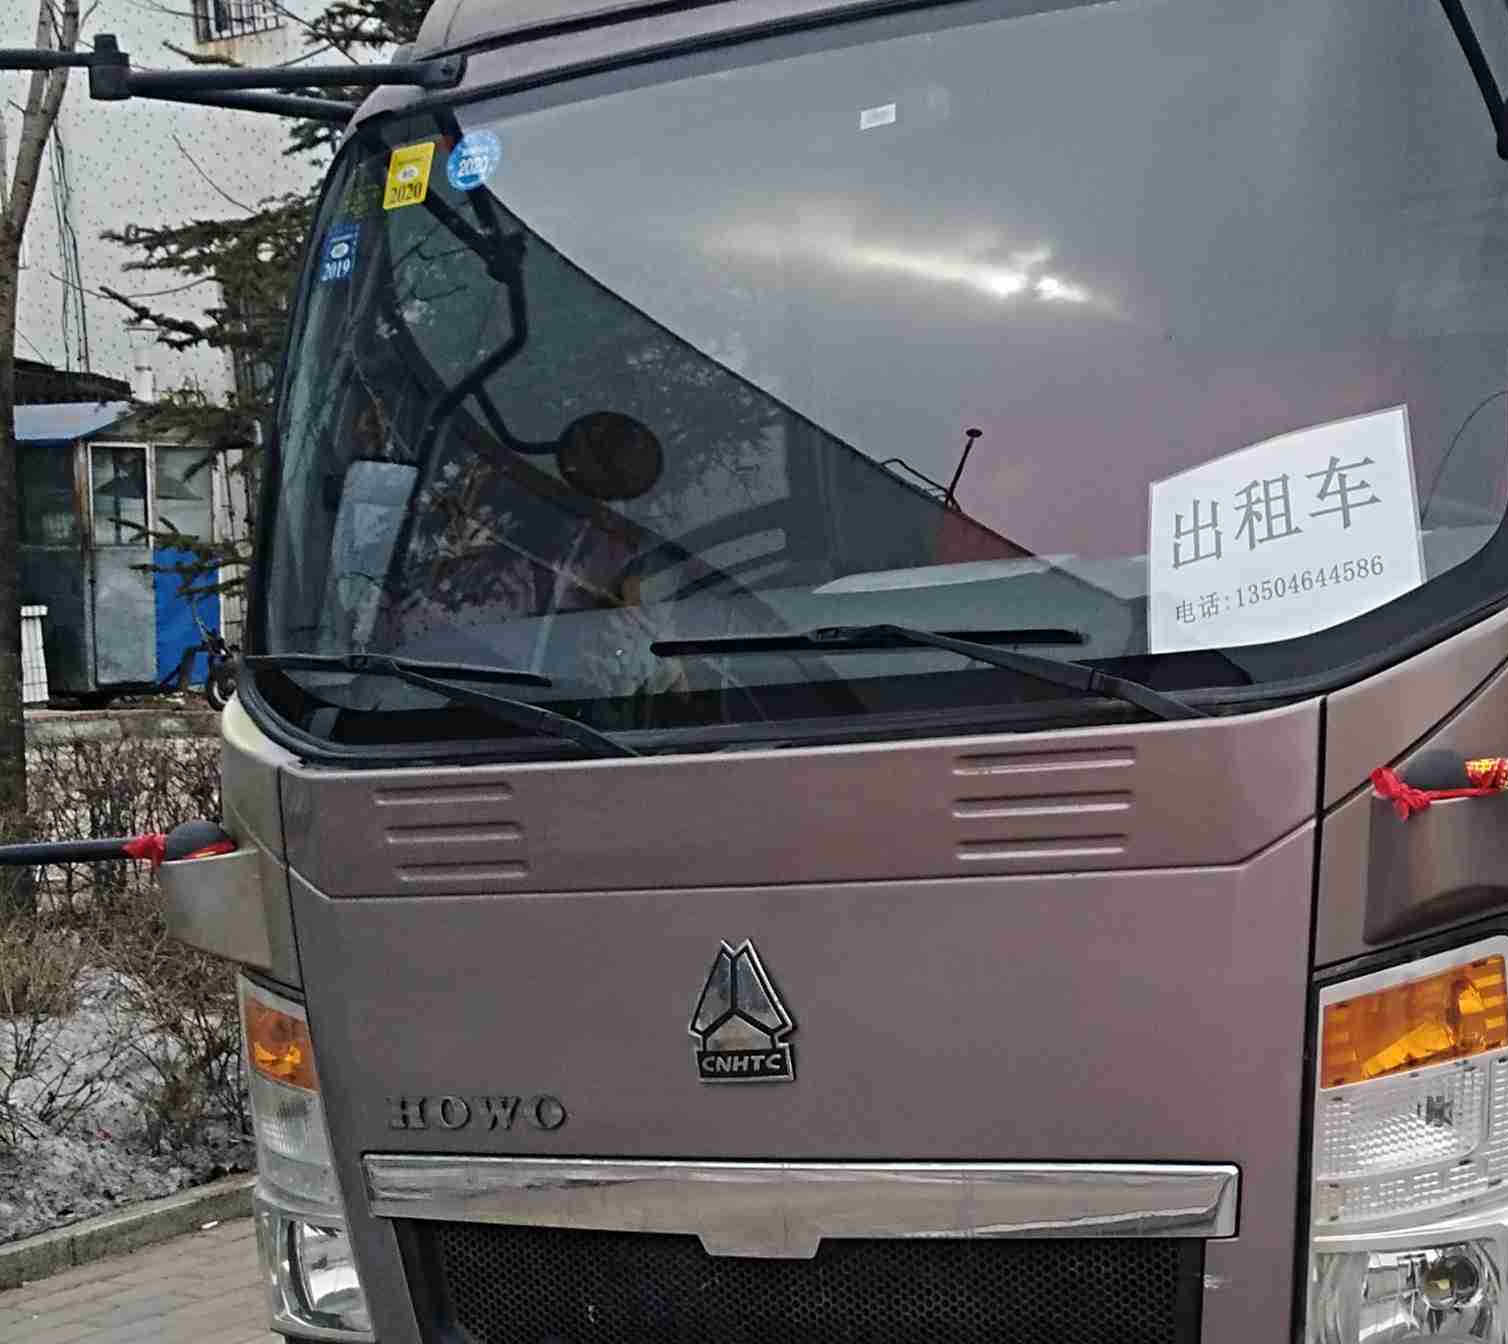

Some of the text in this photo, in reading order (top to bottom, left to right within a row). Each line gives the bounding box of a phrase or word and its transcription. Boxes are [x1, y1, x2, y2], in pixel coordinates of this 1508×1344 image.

[321, 258, 350, 281] 2019
[1172, 456, 1382, 570] 出租车
[701, 1054, 782, 1073] CNHTC
[387, 1096, 566, 1131] HOWO
